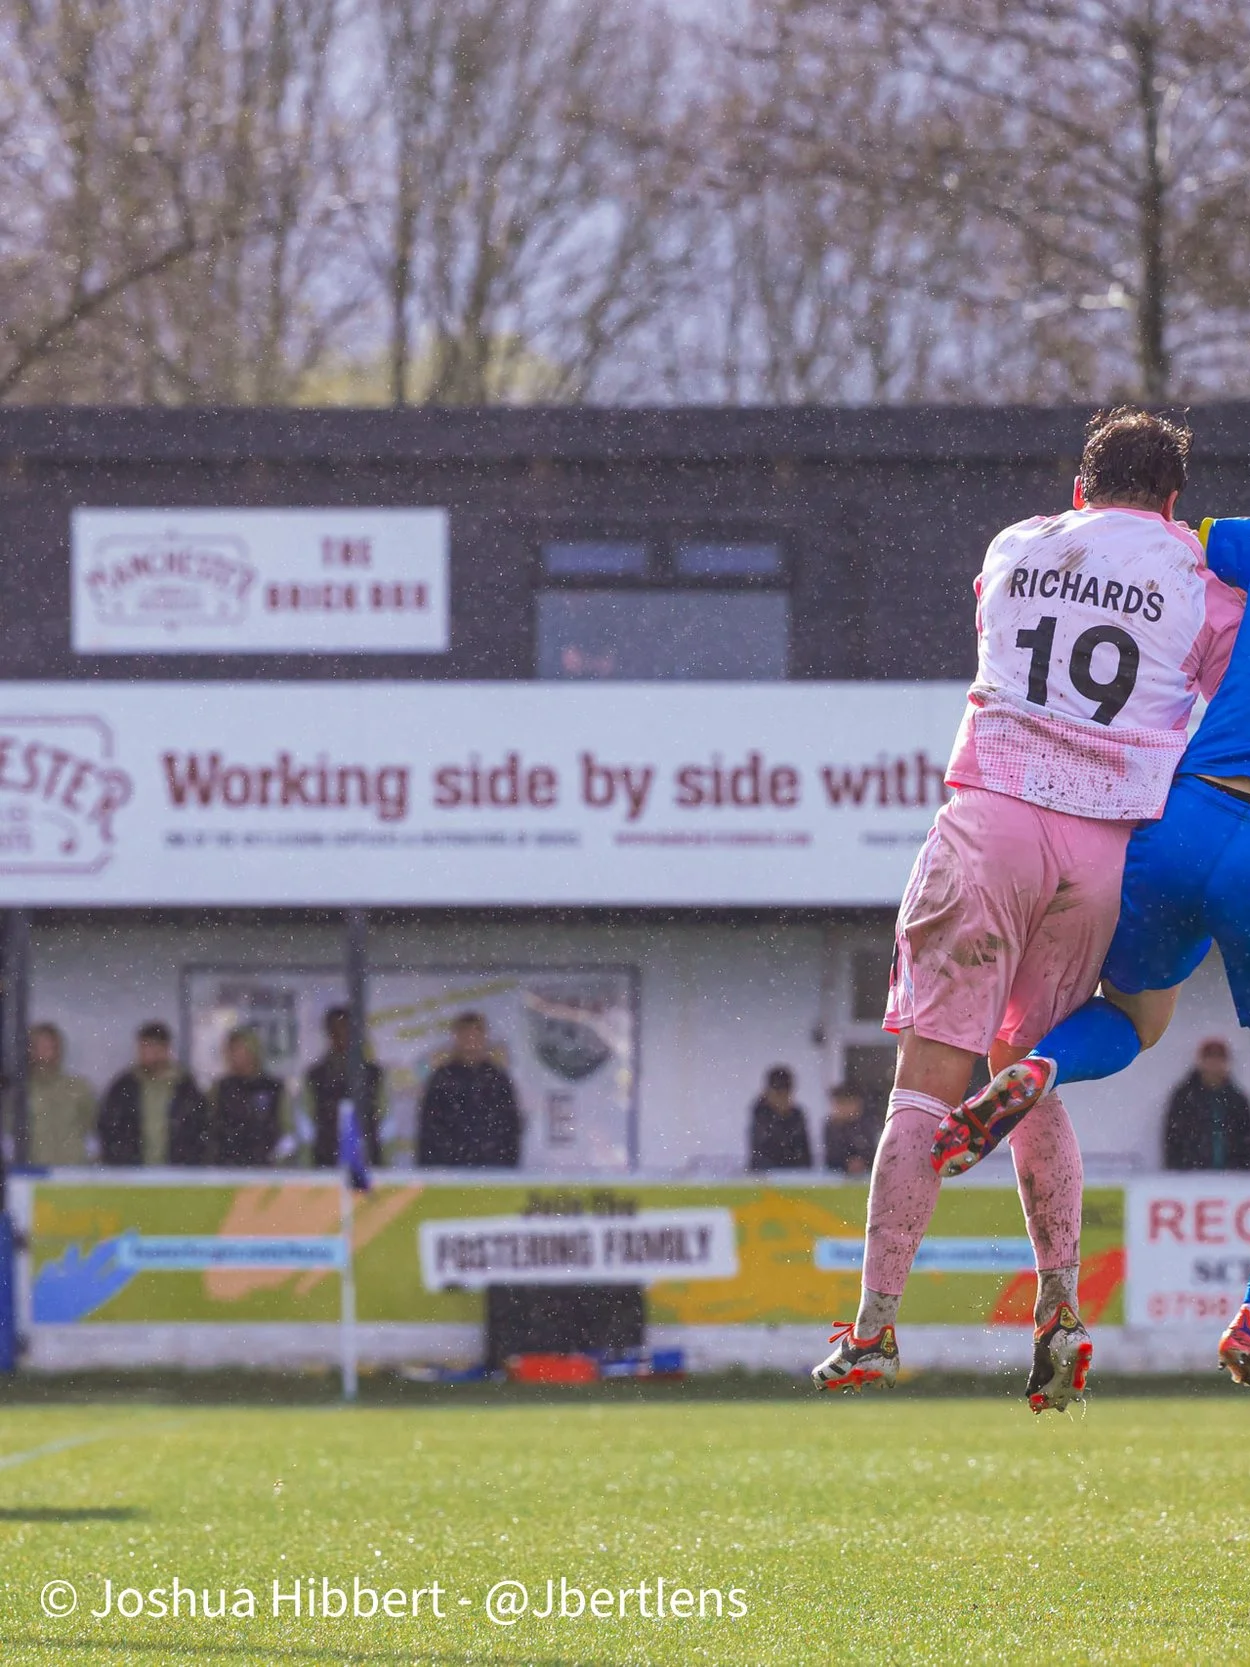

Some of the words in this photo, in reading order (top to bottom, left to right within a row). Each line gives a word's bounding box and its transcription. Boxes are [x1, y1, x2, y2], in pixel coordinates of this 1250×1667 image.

[1009, 568, 1165, 622] RICHARDS
[1015, 616, 1140, 727] 19
[162, 750, 409, 822] Working
[434, 750, 558, 808] side
[580, 750, 655, 821] by
[674, 750, 800, 808] side
[820, 750, 946, 808] with
[436, 1230, 595, 1273] FOSTERING
[603, 1223, 713, 1265] FAMILY
